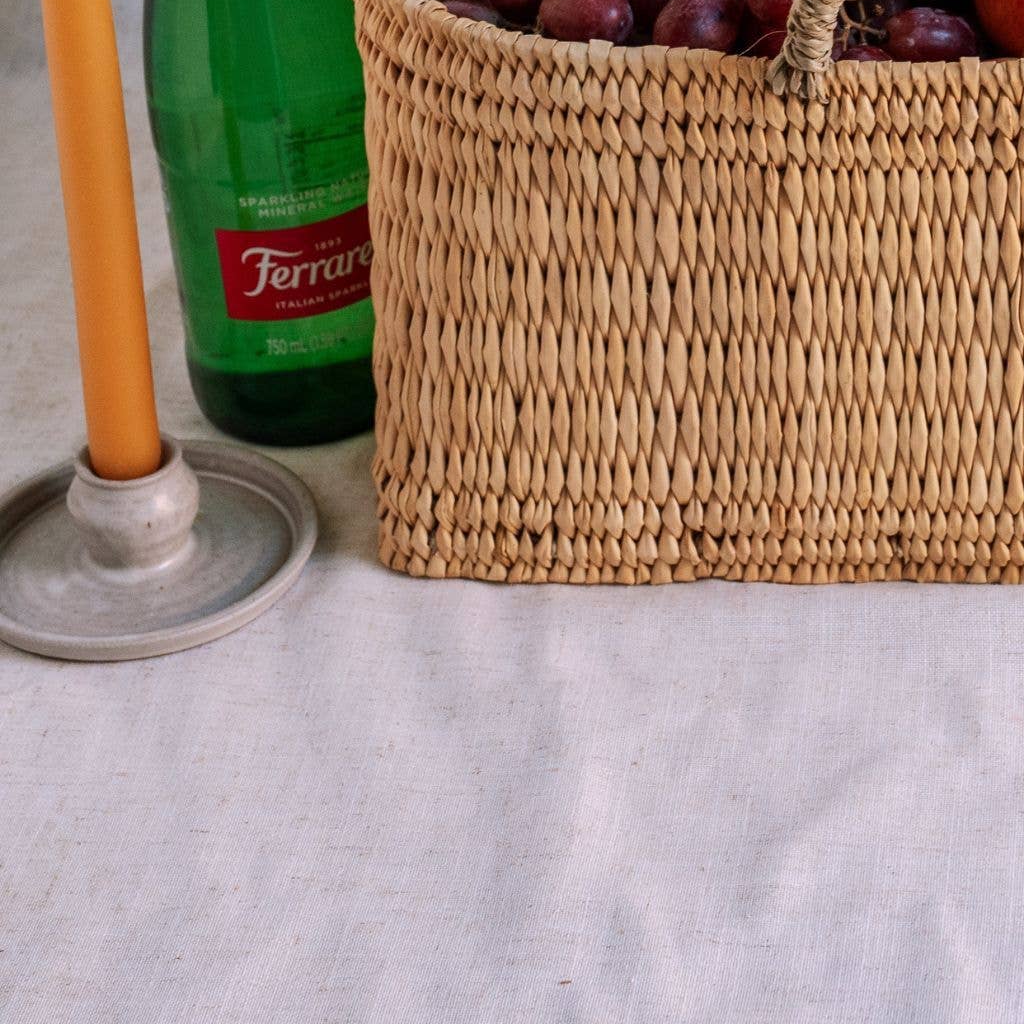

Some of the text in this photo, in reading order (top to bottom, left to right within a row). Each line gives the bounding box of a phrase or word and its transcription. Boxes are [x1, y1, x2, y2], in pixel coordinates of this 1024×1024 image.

[238, 186, 326, 209] SPARKLING
[258, 200, 326, 218] MINERAL
[240, 240, 374, 298] Ferrare
[275, 295, 325, 310] ITALIAN
